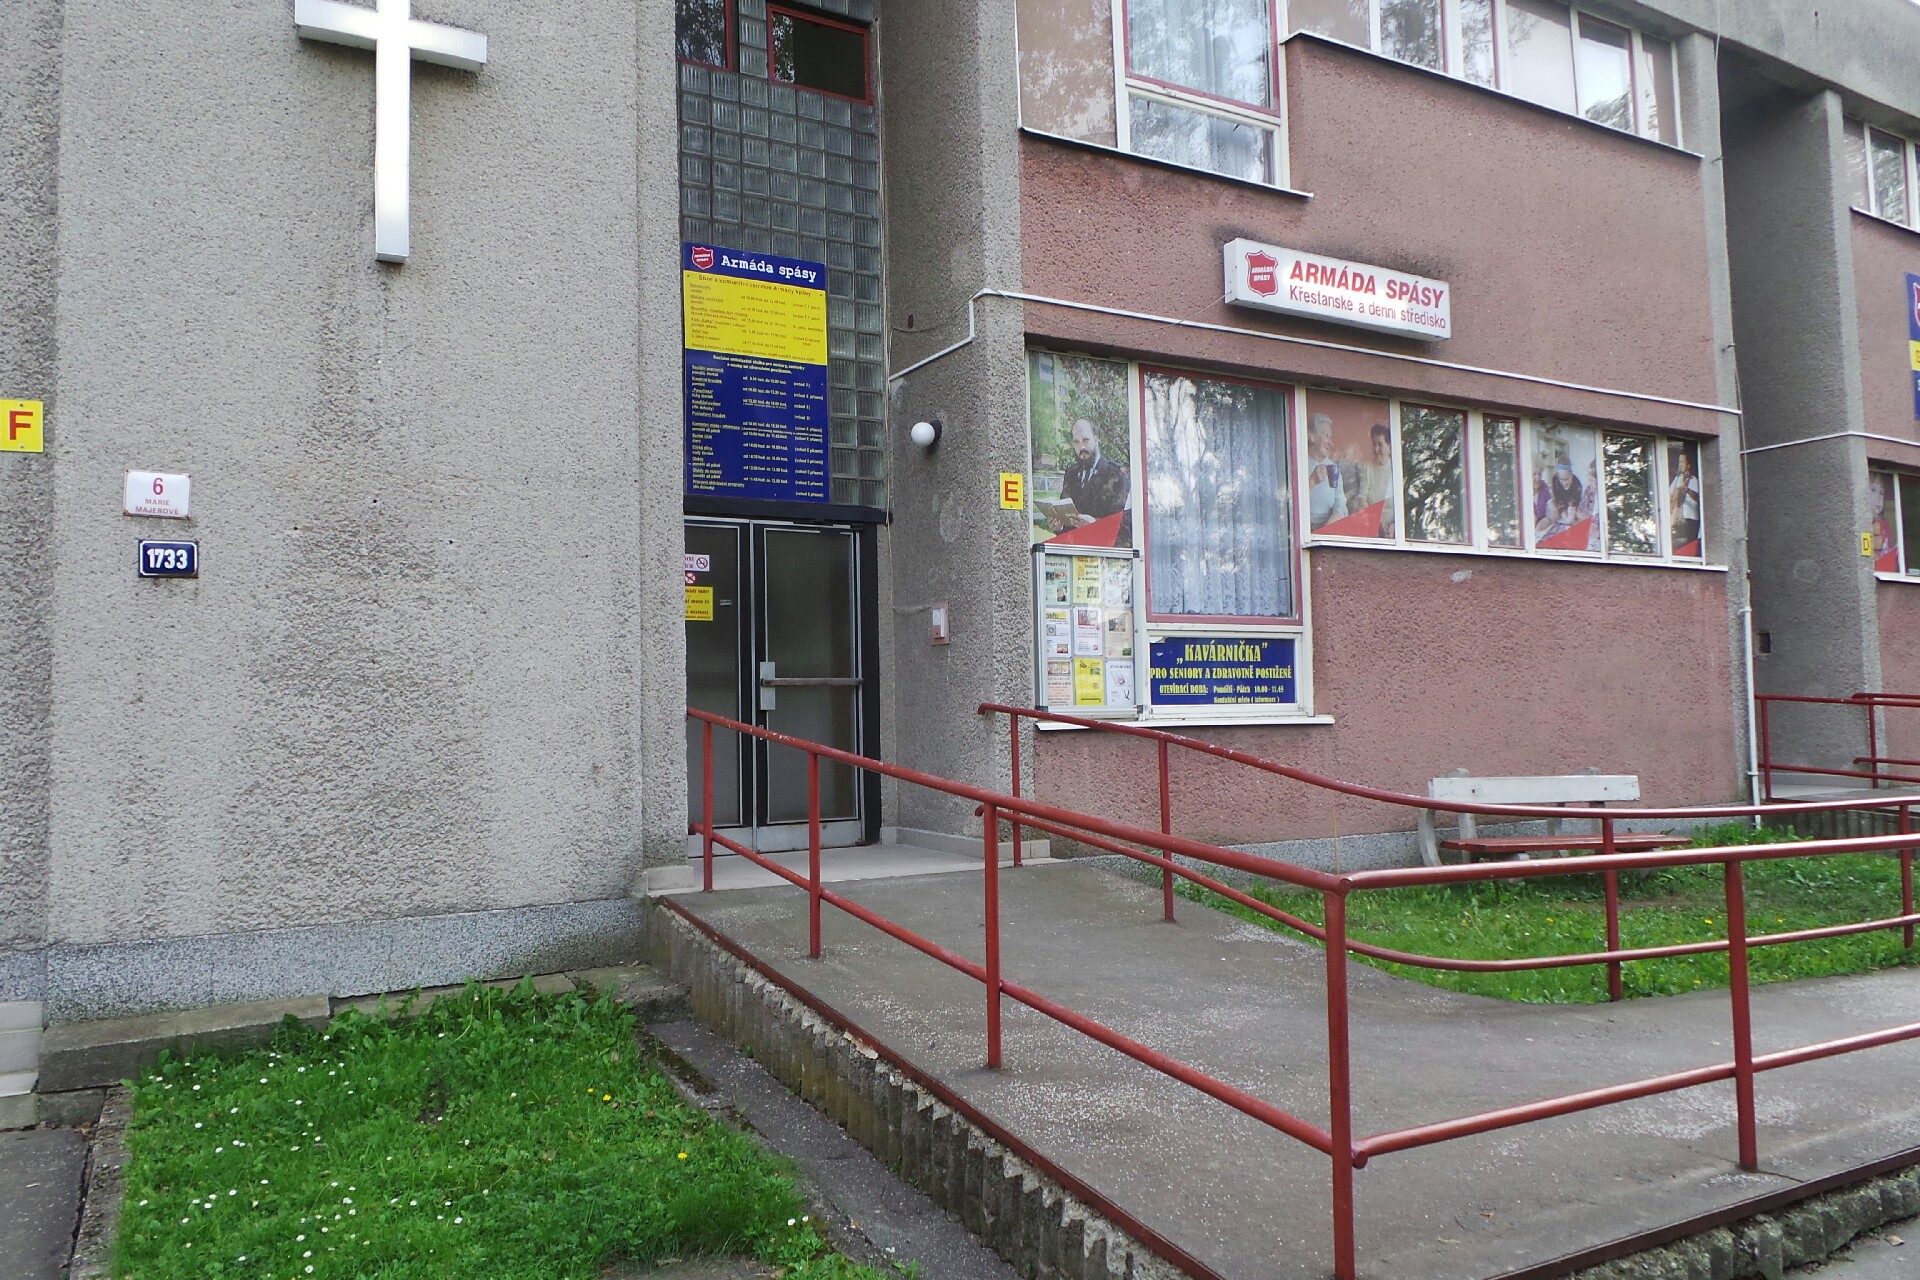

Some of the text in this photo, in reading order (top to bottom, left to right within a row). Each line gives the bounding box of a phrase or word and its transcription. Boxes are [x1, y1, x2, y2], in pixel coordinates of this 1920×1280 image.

[721, 255, 816, 283] Armáda spásy
[1290, 260, 1444, 308] ARMÁDA SPÁSY
[1359, 302, 1364, 313] a
[1400, 308, 1446, 328] středisko
[9, 411, 33, 440] F
[153, 477, 164, 495] 6
[1004, 481, 1019, 502] E
[1863, 538, 1870, 550] D
[147, 548, 188, 569] 1733
[1150, 665, 1292, 678] PRO SENIORY A ZDRAVOTNĚ POSTIŽENÉ
[1190, 685, 1208, 693] DOBA:
